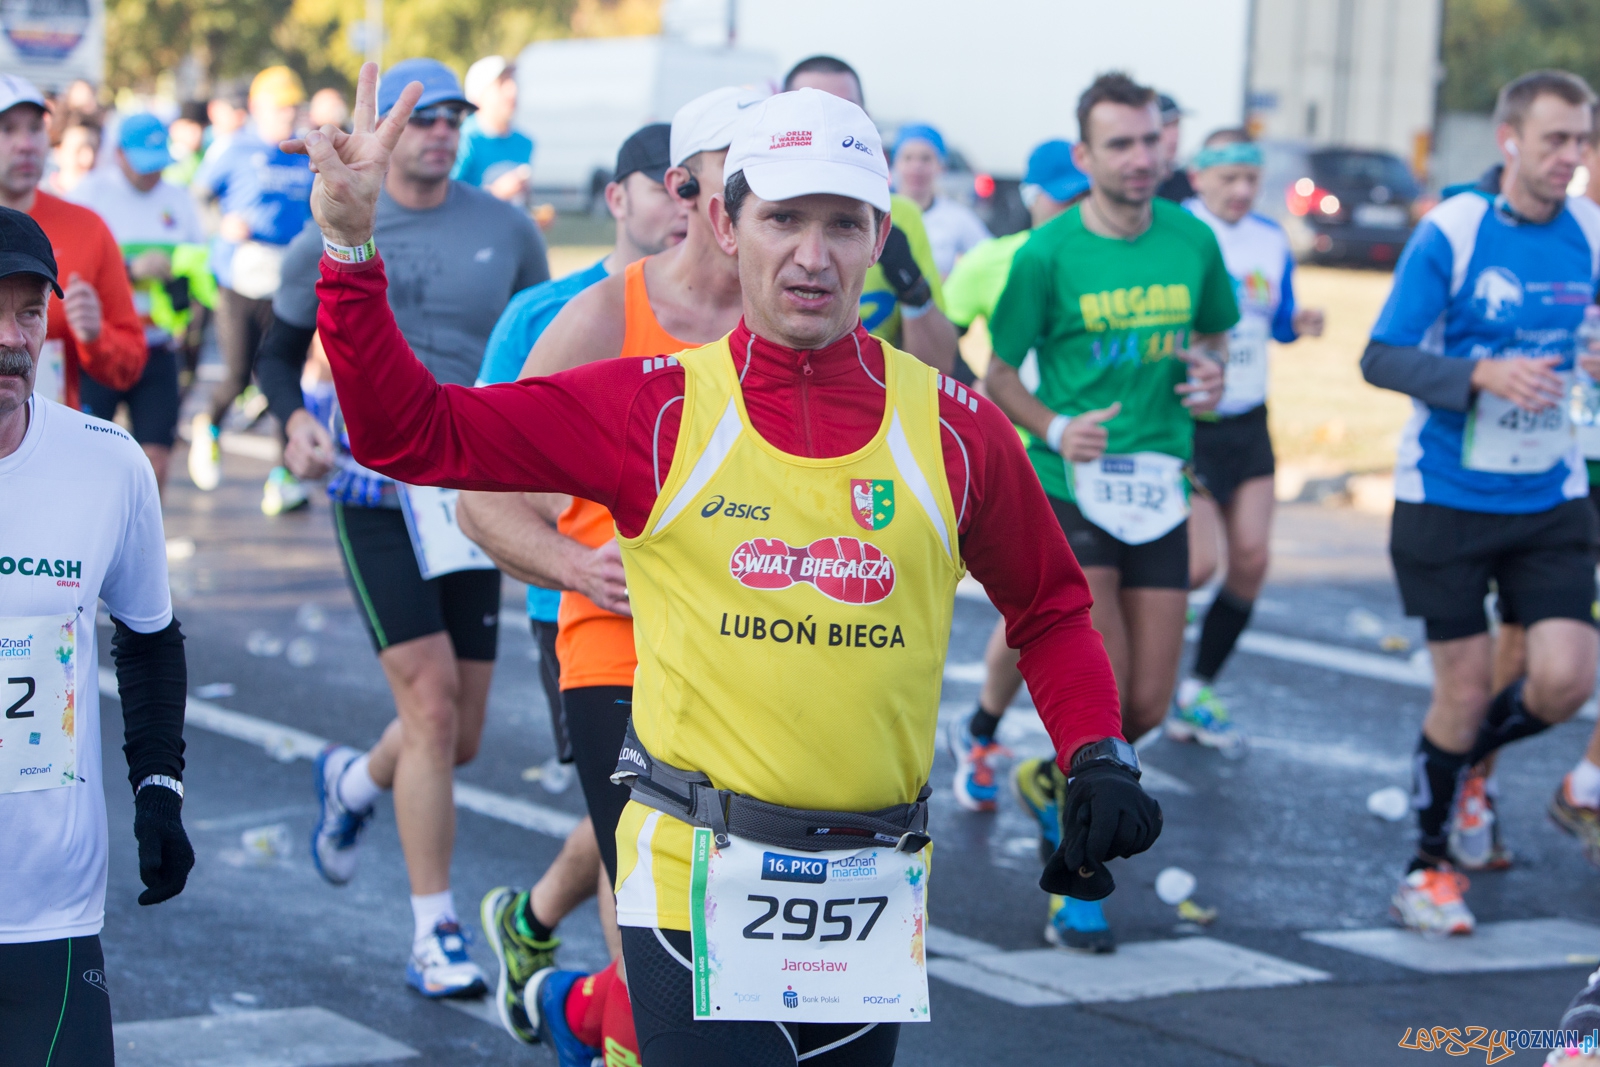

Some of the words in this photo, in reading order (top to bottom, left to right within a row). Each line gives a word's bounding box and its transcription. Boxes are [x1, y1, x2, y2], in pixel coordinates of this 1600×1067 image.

[769, 141, 812, 151] MARATHON
[84, 423, 130, 441] newline
[1093, 480, 1167, 513] 3332
[723, 502, 771, 521] asics
[0, 556, 82, 579] OCASH
[731, 548, 797, 576] ŚWIAT
[800, 556, 891, 580] BIEGACZA
[56, 580, 81, 588] GRUPA
[720, 612, 817, 646] LUBOŃ
[827, 622, 906, 649] BIEGA
[0, 647, 31, 657] raton
[5, 676, 36, 719] 2
[768, 858, 788, 873] 16.
[791, 860, 823, 876] PKO
[832, 866, 877, 878] maraton
[742, 894, 889, 942] 2957
[781, 958, 848, 972] Jarosław
[802, 995, 819, 1004] Bank
[820, 995, 840, 1004] Polski
